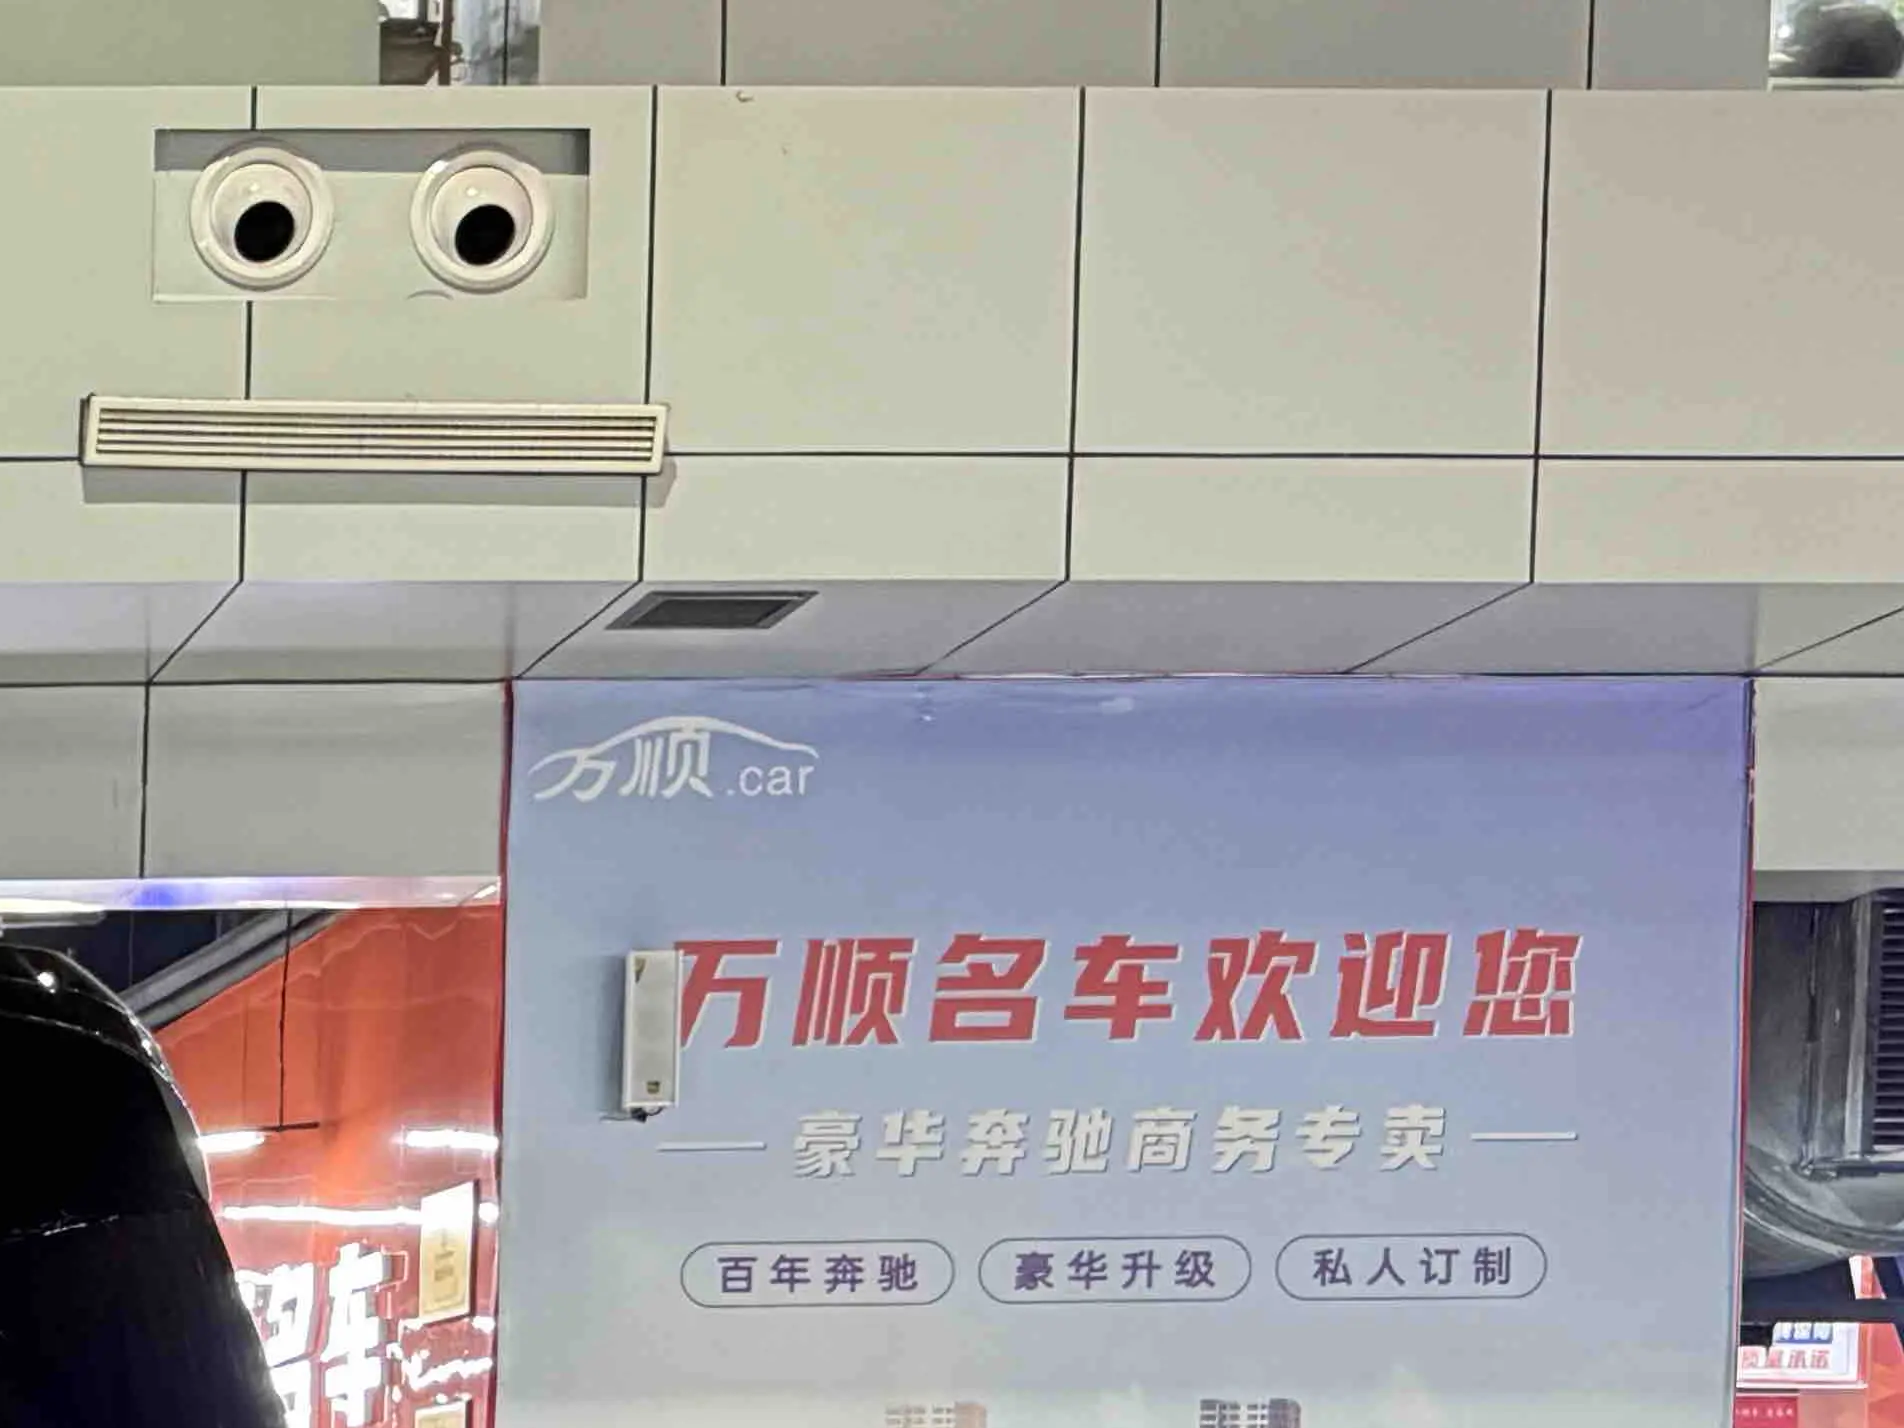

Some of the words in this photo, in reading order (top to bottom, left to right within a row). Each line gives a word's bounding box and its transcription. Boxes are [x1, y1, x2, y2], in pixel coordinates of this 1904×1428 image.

[672, 926, 1584, 1050] 万顺名车欢迎您
[793, 1105, 1447, 1178] 豪华奔驰商务专卖
[717, 1254, 919, 1294] 百年奔驰
[1013, 1251, 1217, 1290] 豪华升级
[1312, 1247, 1513, 1288] 私人订制
